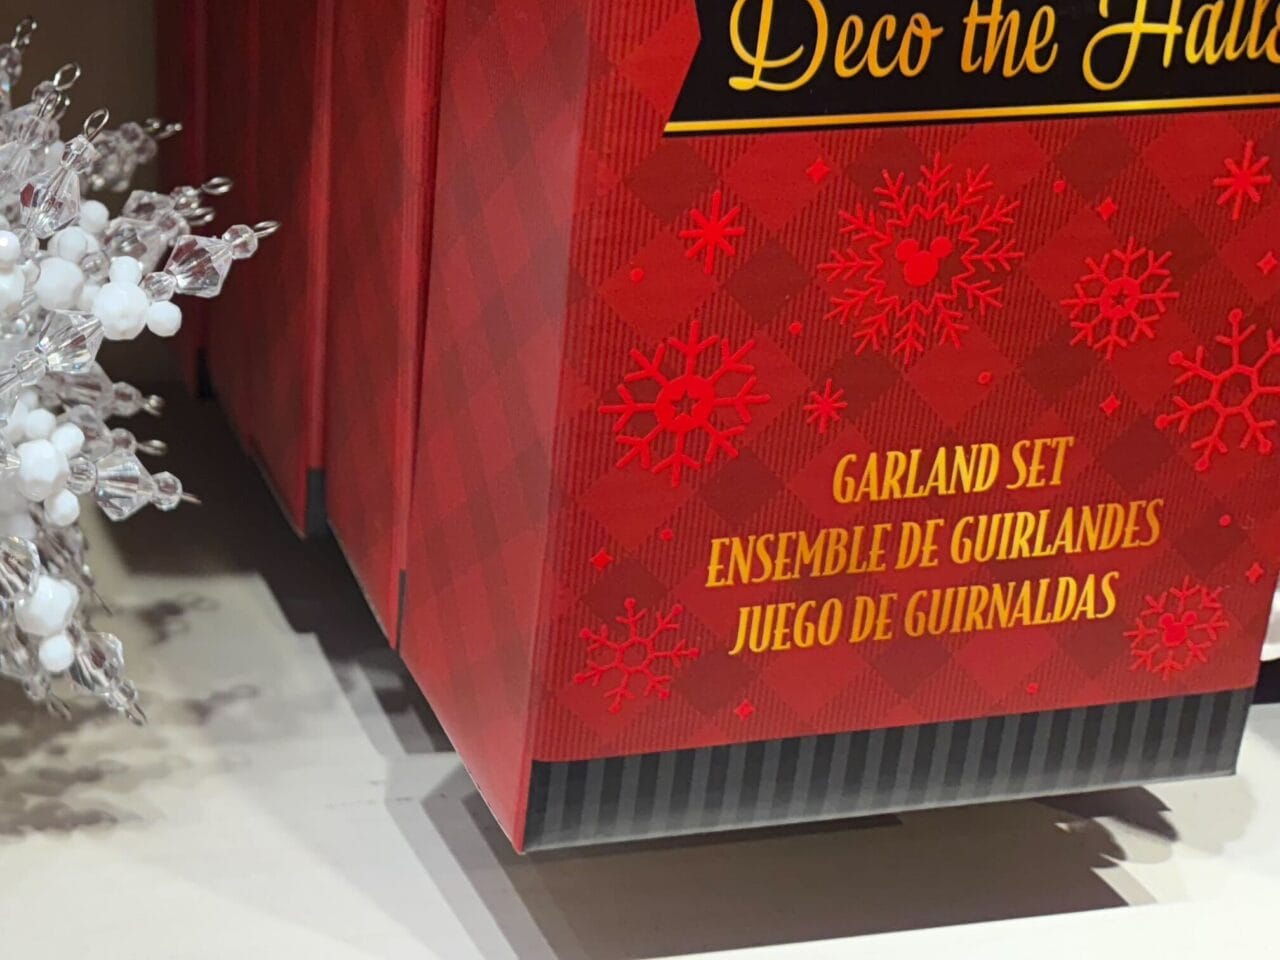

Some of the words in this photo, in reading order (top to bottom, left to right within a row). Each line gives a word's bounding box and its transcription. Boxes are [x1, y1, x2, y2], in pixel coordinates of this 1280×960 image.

[832, 442, 1000, 505] GARLAND
[1006, 436, 1075, 490] SET
[705, 522, 889, 588] ENSEMBLE
[894, 518, 944, 570] DE
[950, 498, 1165, 565] GUIRLANDES
[728, 597, 842, 656] JUEGO
[849, 592, 898, 644] DE
[904, 570, 1120, 638] GUIRNALDAS
